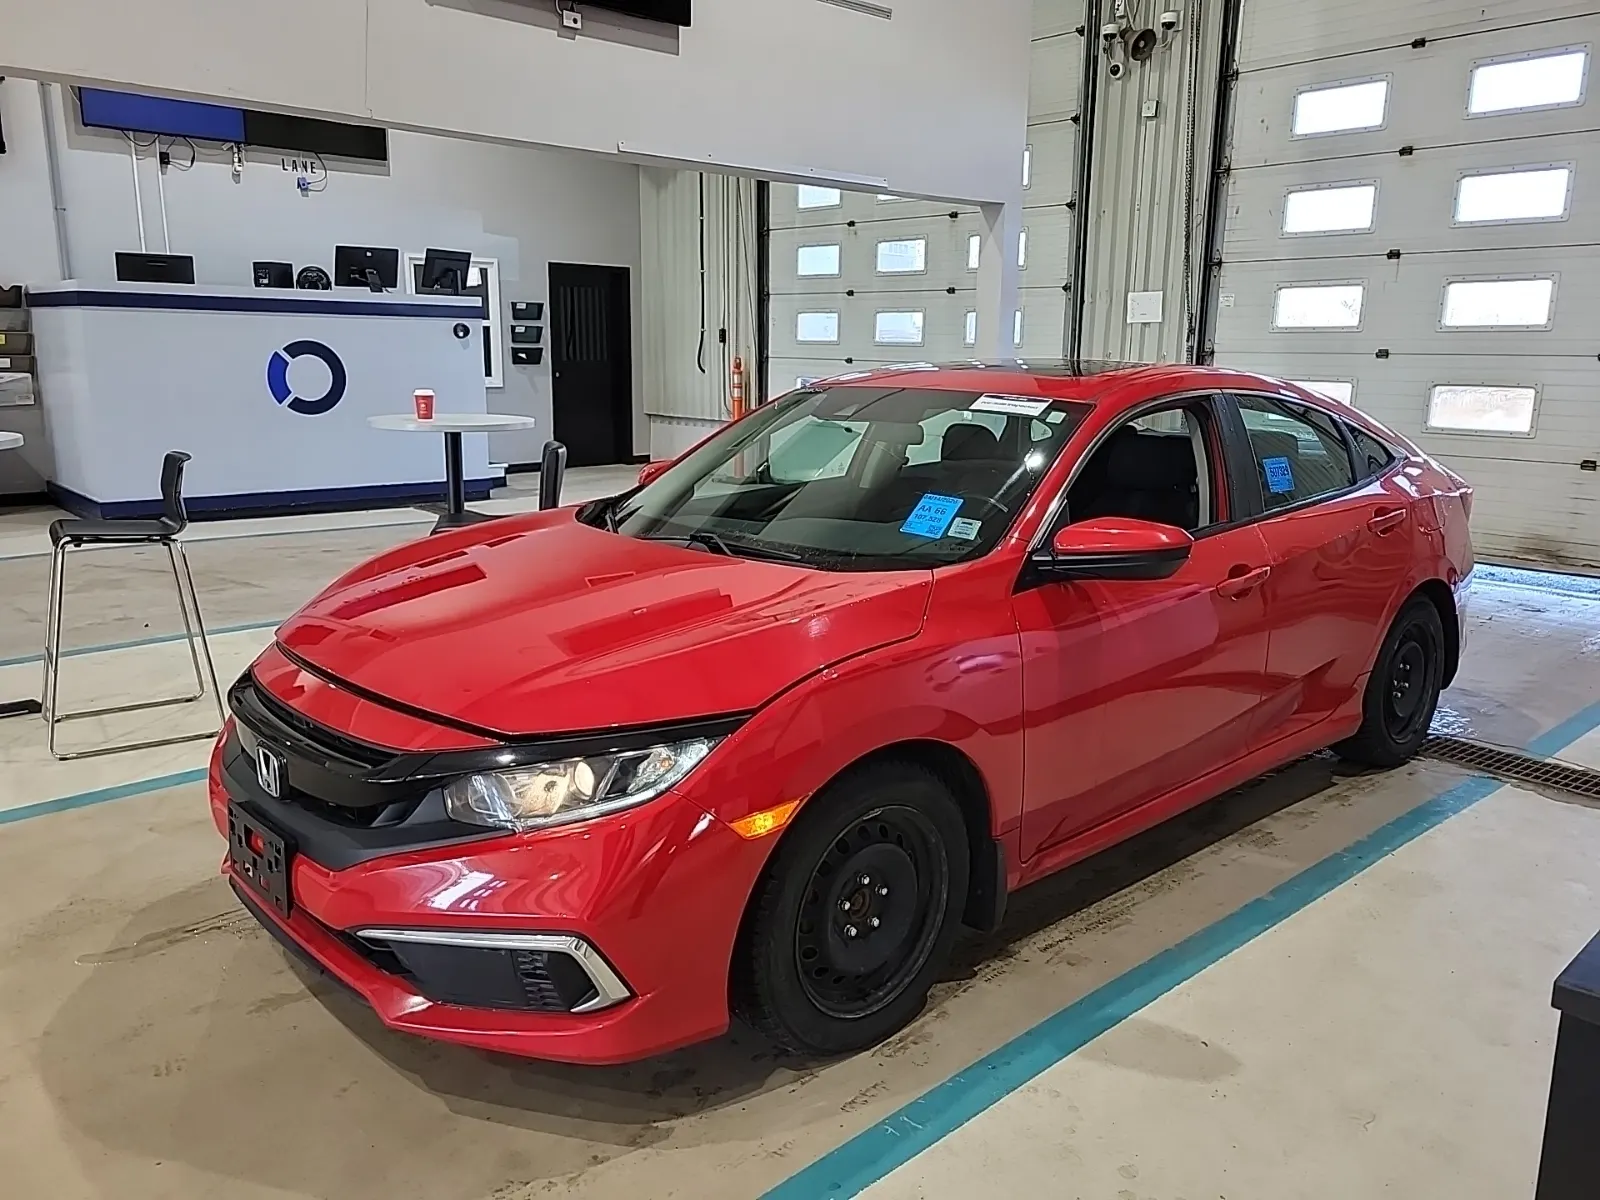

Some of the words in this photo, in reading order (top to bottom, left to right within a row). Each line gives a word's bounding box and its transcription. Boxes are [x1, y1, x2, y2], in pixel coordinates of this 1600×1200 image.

[281, 158, 317, 175] LANE
[917, 504, 932, 513] AA
[934, 507, 948, 515] 66
